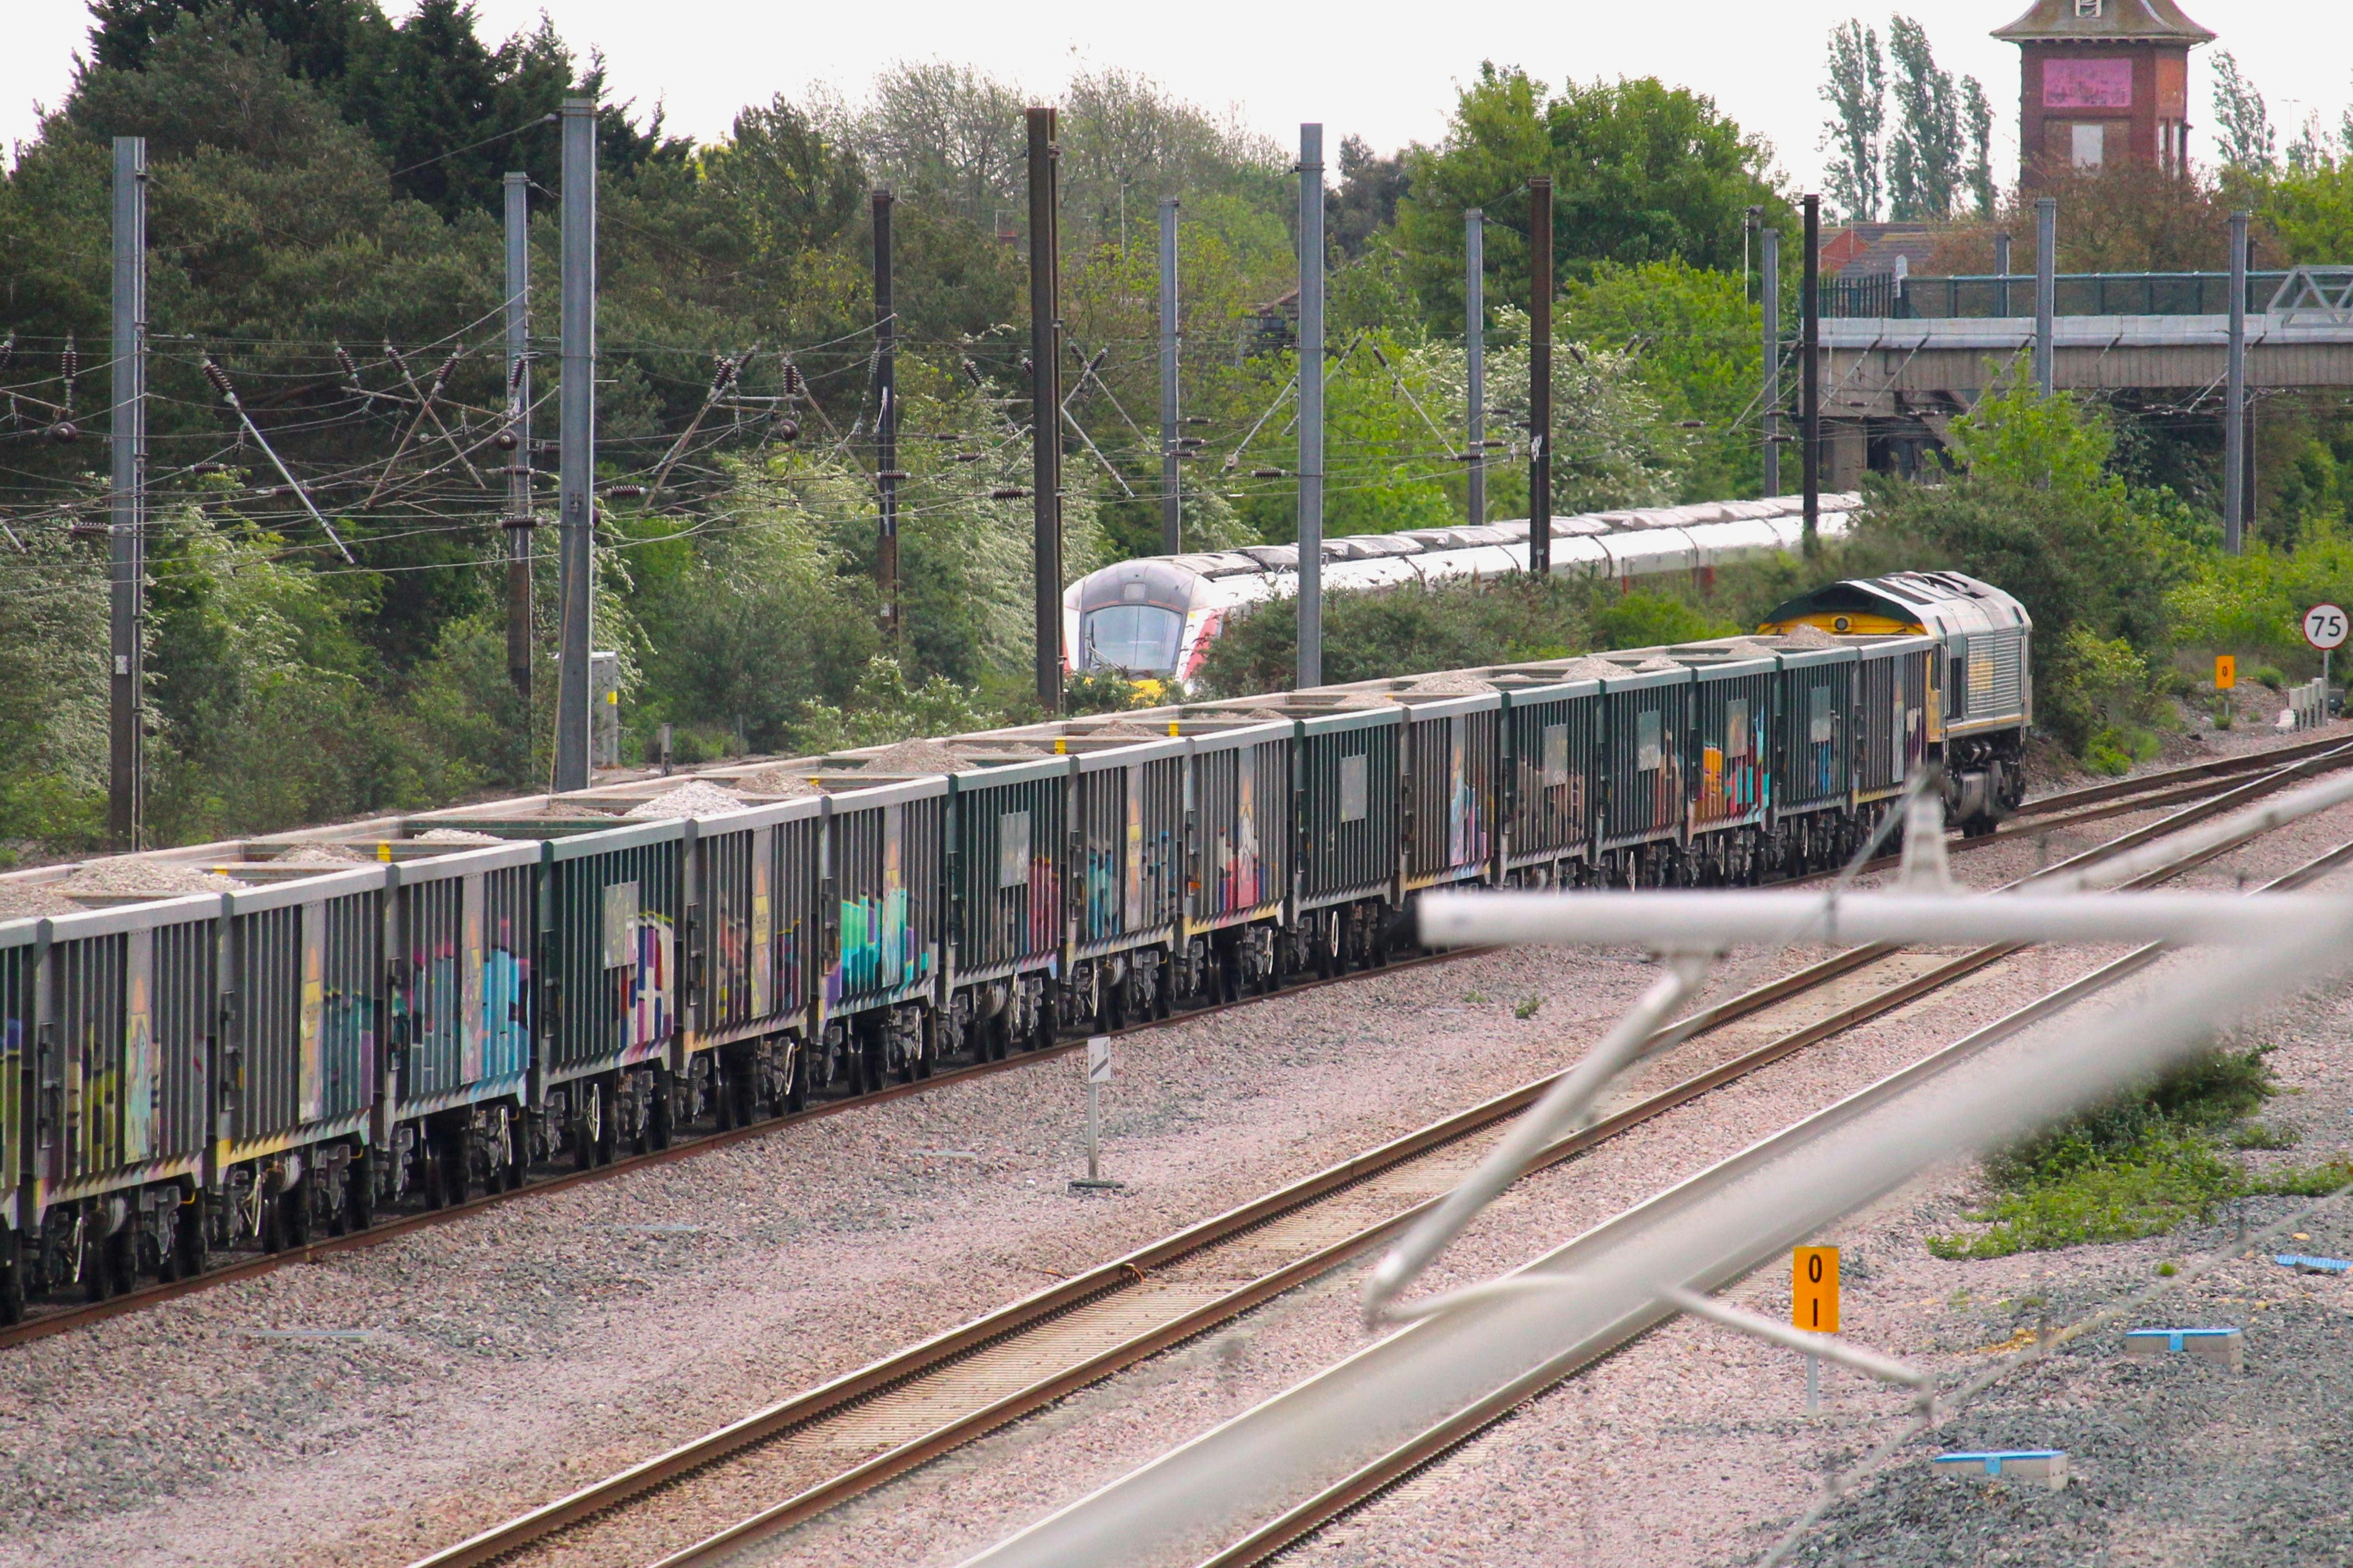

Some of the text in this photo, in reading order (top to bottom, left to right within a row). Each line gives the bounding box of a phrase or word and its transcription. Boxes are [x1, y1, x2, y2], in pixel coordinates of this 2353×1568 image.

[2312, 616, 2341, 637] 75
[2222, 666, 2228, 677] 0
[1809, 1254, 1823, 1283] 0
